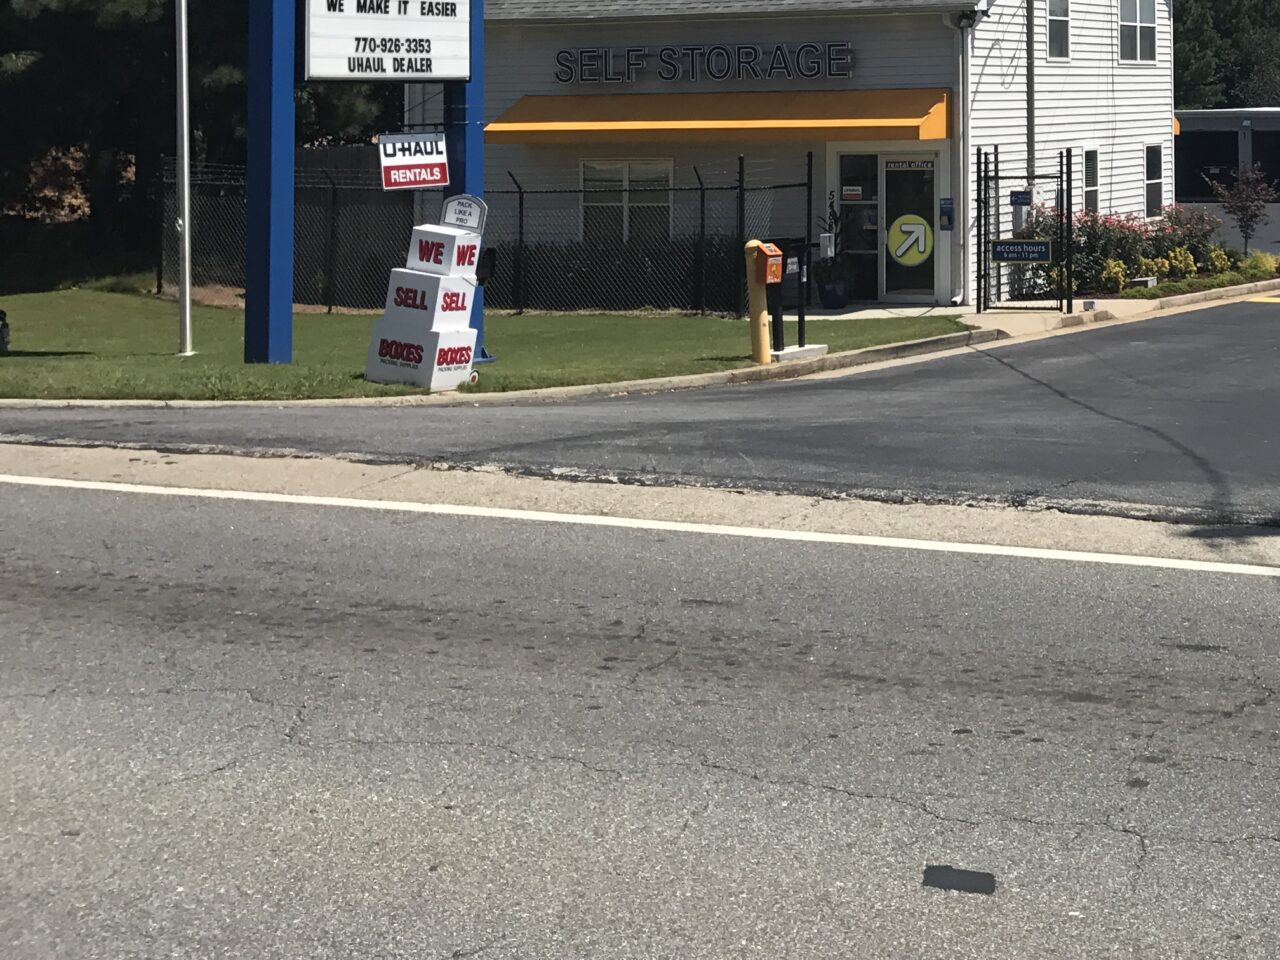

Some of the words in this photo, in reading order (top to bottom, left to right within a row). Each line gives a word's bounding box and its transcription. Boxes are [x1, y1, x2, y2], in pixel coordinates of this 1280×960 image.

[398, 0, 409, 15] IT
[420, 1, 457, 17] EASIER
[354, 37, 432, 53] 770-926-3353
[348, 57, 386, 73] UHAUL
[393, 57, 433, 73] DEALER
[554, 47, 648, 84] SELF
[656, 42, 854, 82] STORAGE
[383, 141, 444, 158] U-HAUL
[887, 161, 909, 169] rental
[911, 161, 932, 169] office
[390, 167, 441, 183] RENTALS
[418, 239, 444, 264] WE
[456, 244, 477, 266] WE
[1023, 244, 1046, 252] hours
[394, 286, 428, 310] SELL
[441, 292, 467, 312] SELL
[378, 338, 424, 364] BOXES
[437, 346, 472, 367] BOXES
